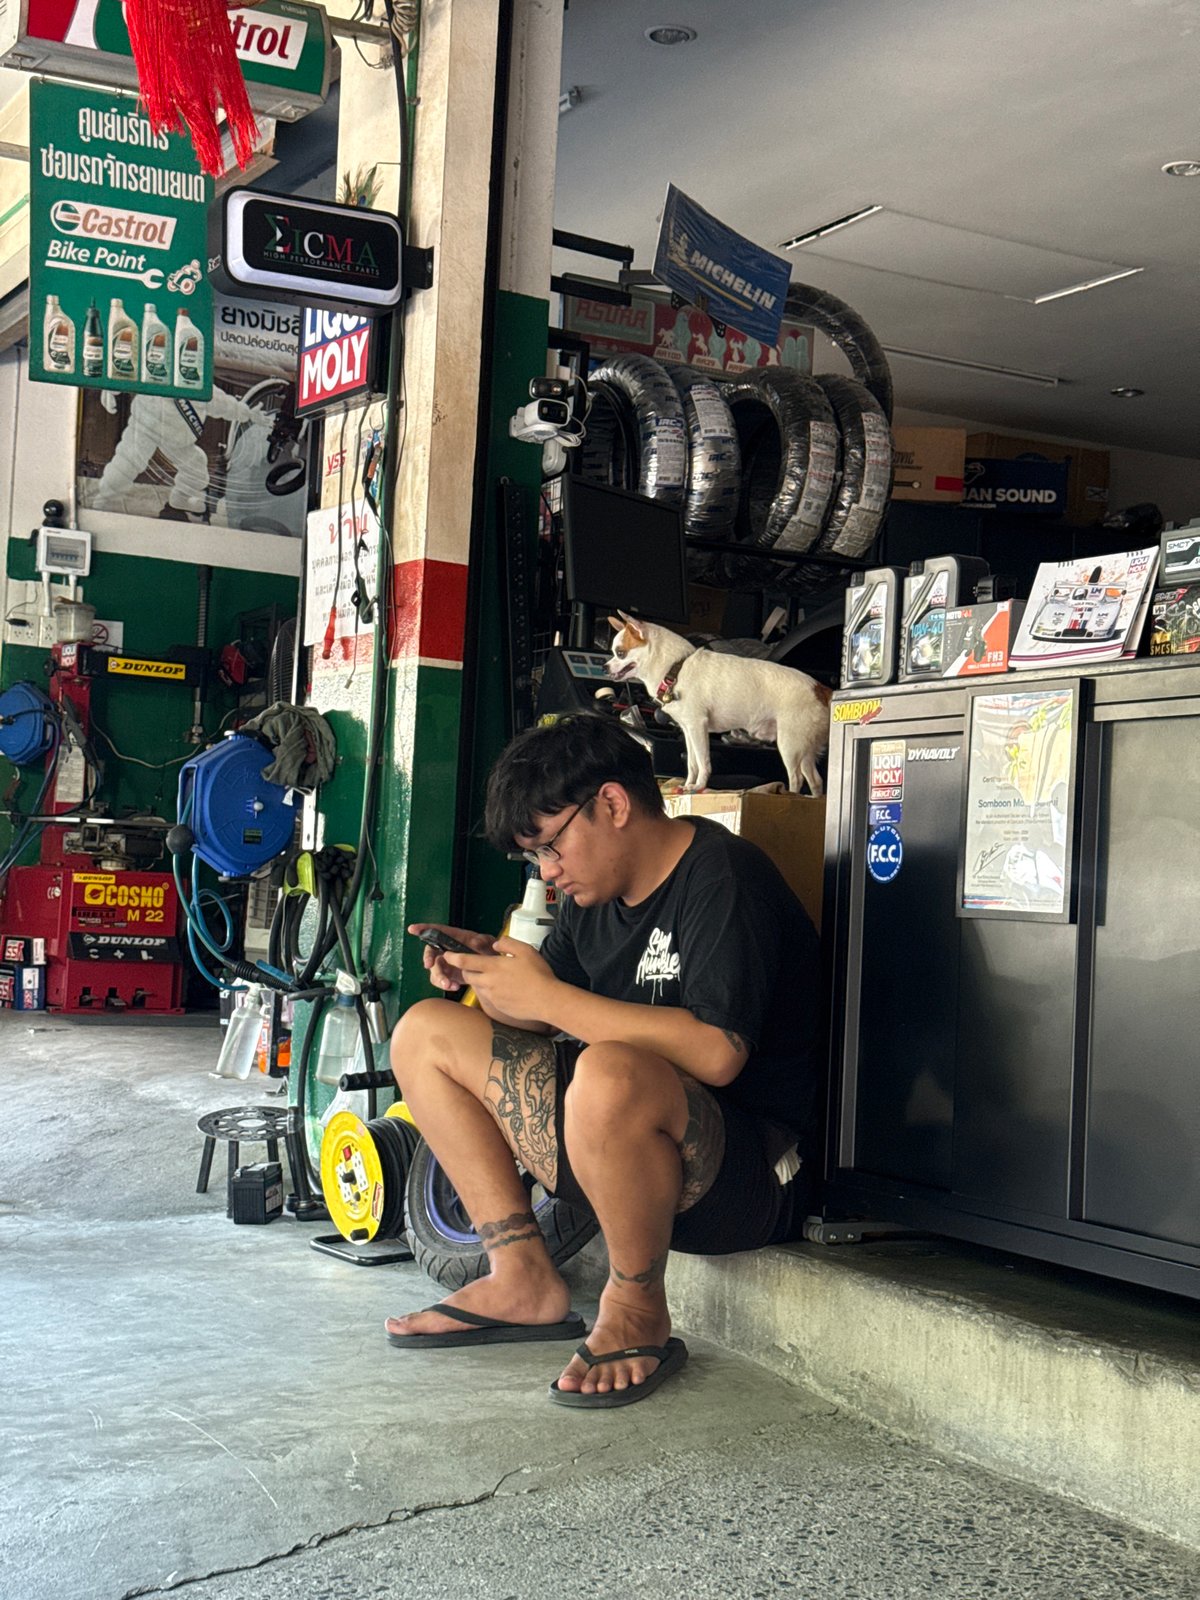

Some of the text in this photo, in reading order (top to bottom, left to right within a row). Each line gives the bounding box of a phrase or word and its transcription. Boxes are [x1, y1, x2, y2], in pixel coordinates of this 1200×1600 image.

[229, 15, 291, 59] trol
[82, 207, 167, 245] Castrol
[47, 239, 146, 271] Bike Point
[263, 251, 381, 276] HIGH PERFORMANCE PARTS
[690, 250, 777, 310] MICHELIN
[302, 330, 370, 400] MOLY
[995, 488, 1057, 504] SOUND
[987, 650, 1003, 662] FH3
[121, 661, 184, 676] DUNLOP
[873, 755, 901, 769] LIQUI
[873, 770, 902, 784] MOLY
[977, 798, 1012, 808] Somboon
[871, 844, 899, 863] F.C.C.
[105, 884, 165, 908] COSMO
[127, 909, 164, 923] M 22
[98, 935, 167, 946] DUNLOP
